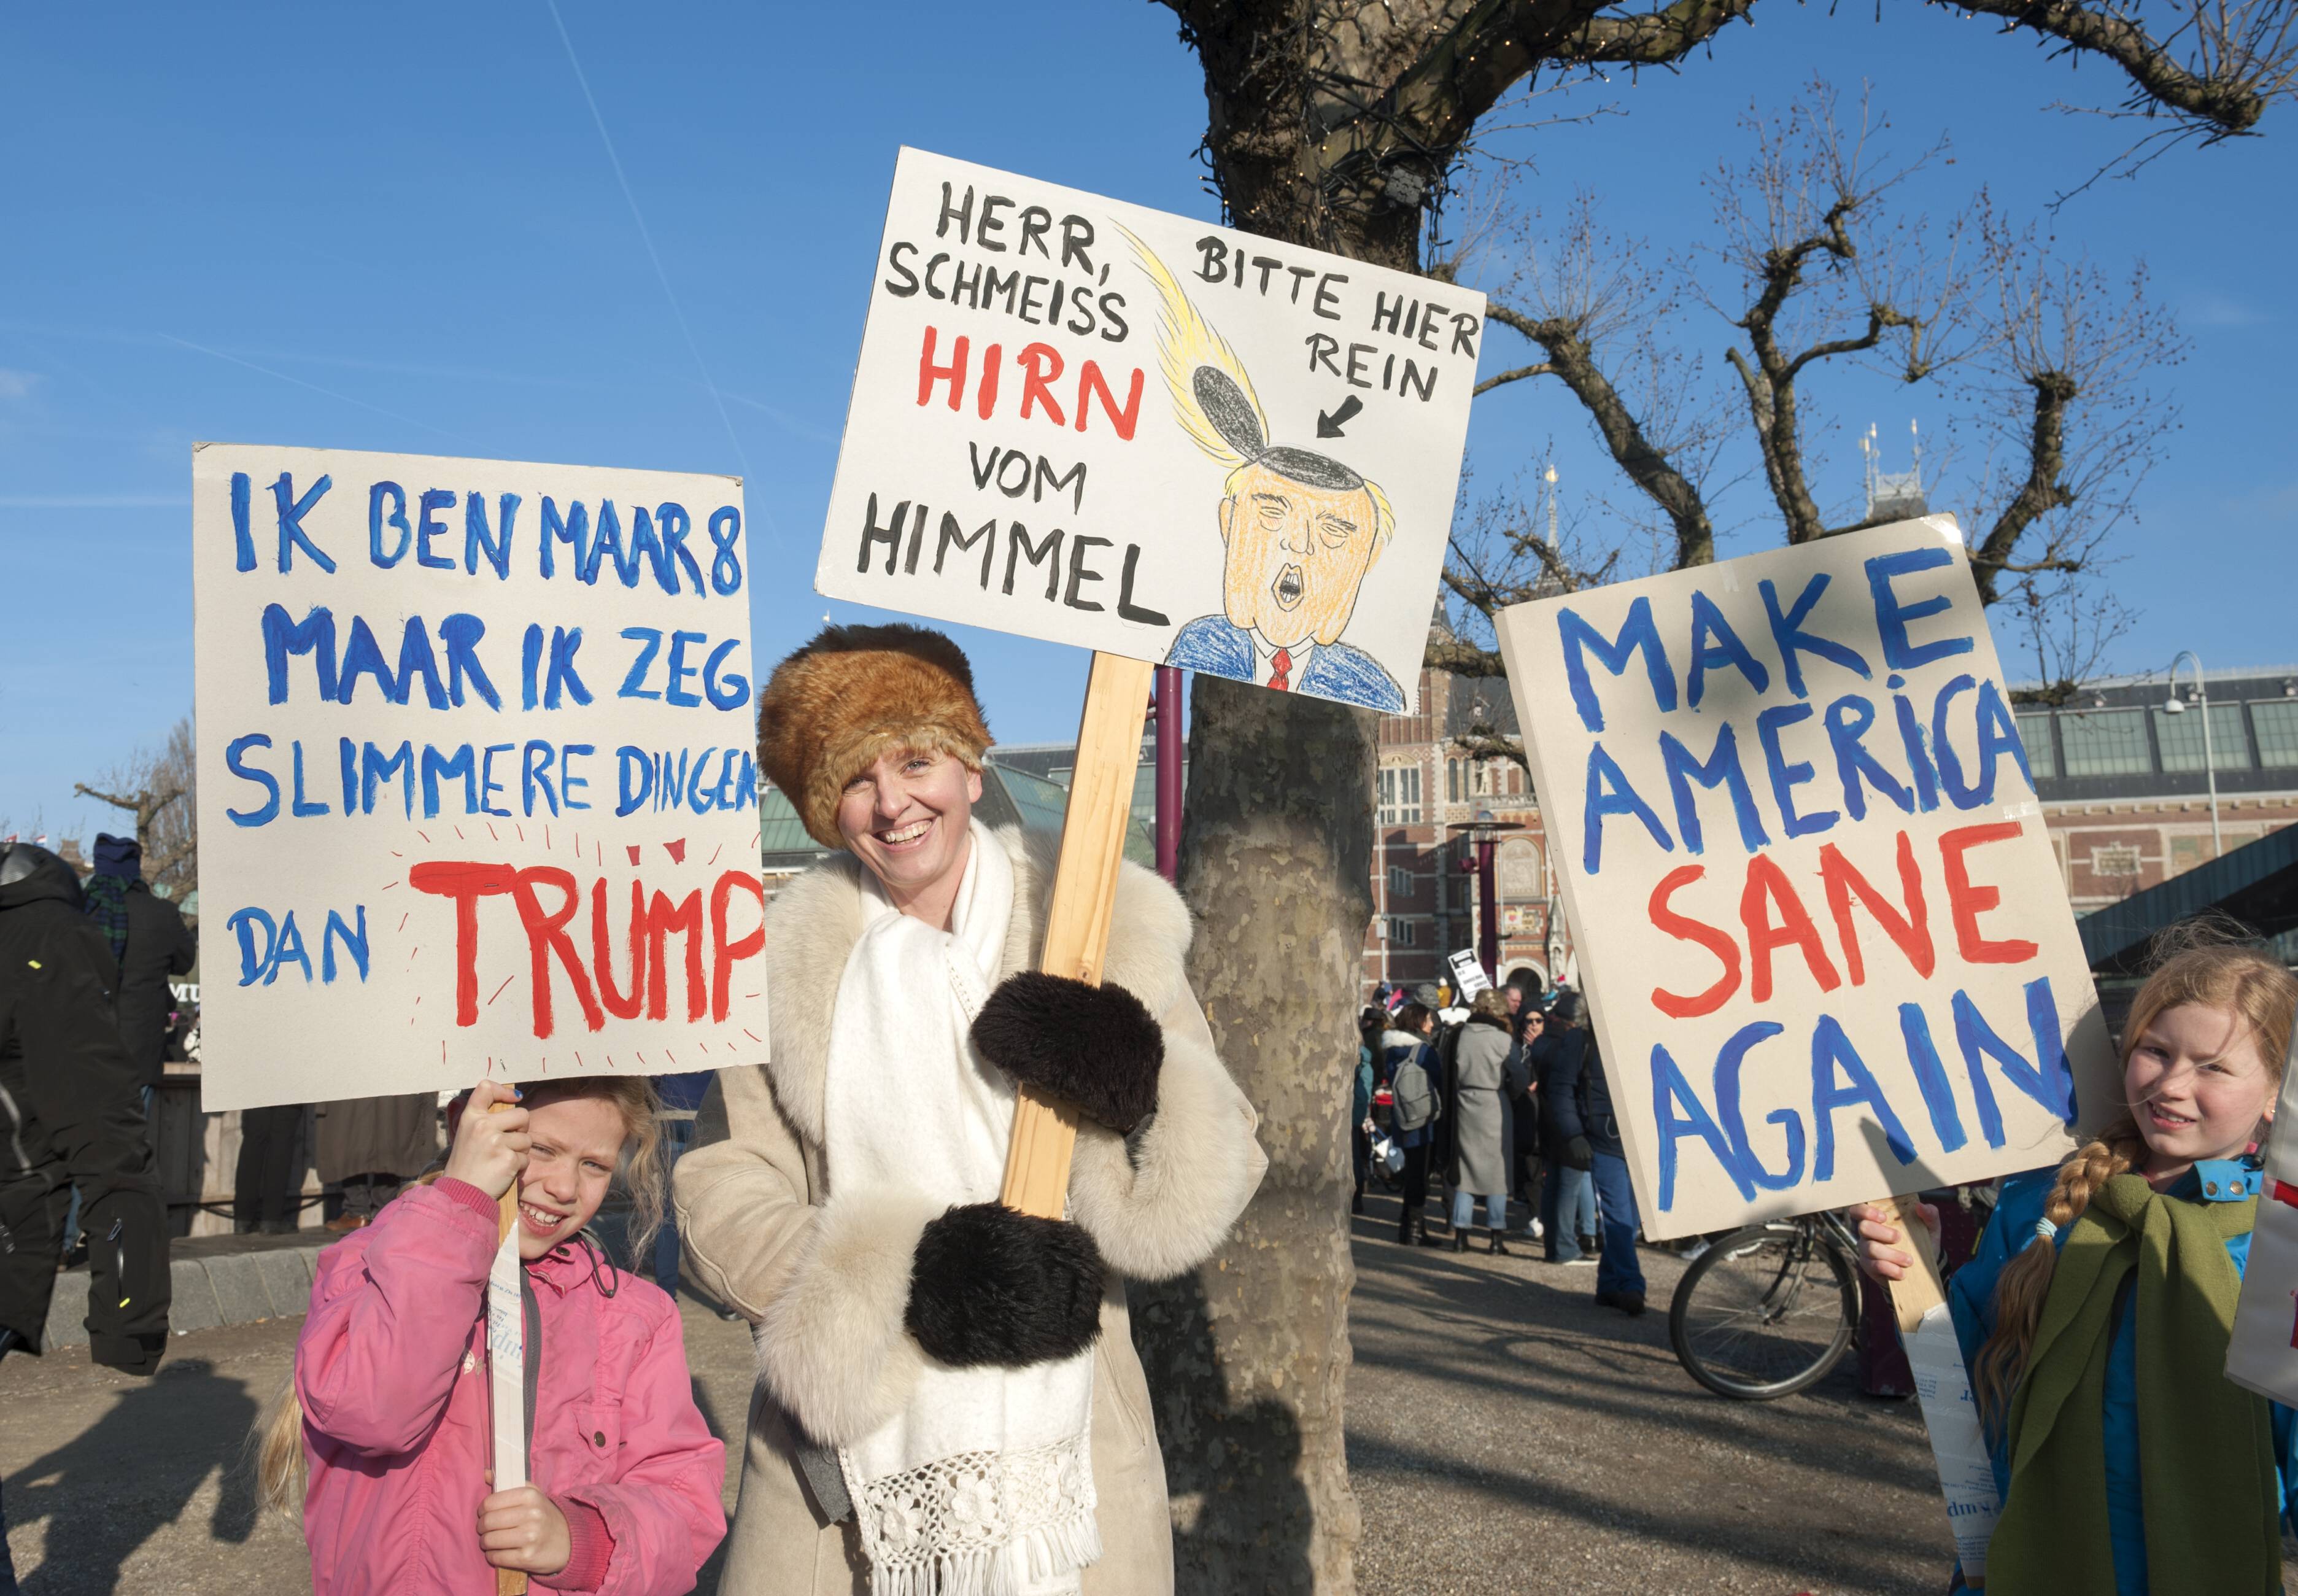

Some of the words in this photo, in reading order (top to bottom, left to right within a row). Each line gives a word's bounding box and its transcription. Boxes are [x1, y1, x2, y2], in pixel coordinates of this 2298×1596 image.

[885, 242, 1128, 342] SCHMEISS
[937, 182, 1109, 285] HERR,
[1194, 236, 1348, 320] BITTE
[1372, 292, 1479, 358] HIER
[918, 327, 1143, 440] HIRN
[1306, 333, 1437, 401] REIN
[231, 473, 335, 573] IK
[370, 482, 520, 579] BEN
[540, 497, 705, 597] MAAR
[709, 506, 741, 595] 8
[970, 442, 1086, 514] VOM
[857, 492, 1170, 626] HIMMEL
[263, 602, 500, 710] MAAR
[523, 624, 592, 710] IK
[619, 628, 749, 710] ZEG
[1559, 548, 1973, 731] MAKE
[226, 733, 594, 826] SLIMMERE
[616, 746, 756, 816] DINGEN
[228, 906, 368, 985] DAN
[409, 861, 765, 1039] TRUMP
[1649, 822, 2038, 1018] SANE
[1652, 978, 2078, 1210] AGAIN
